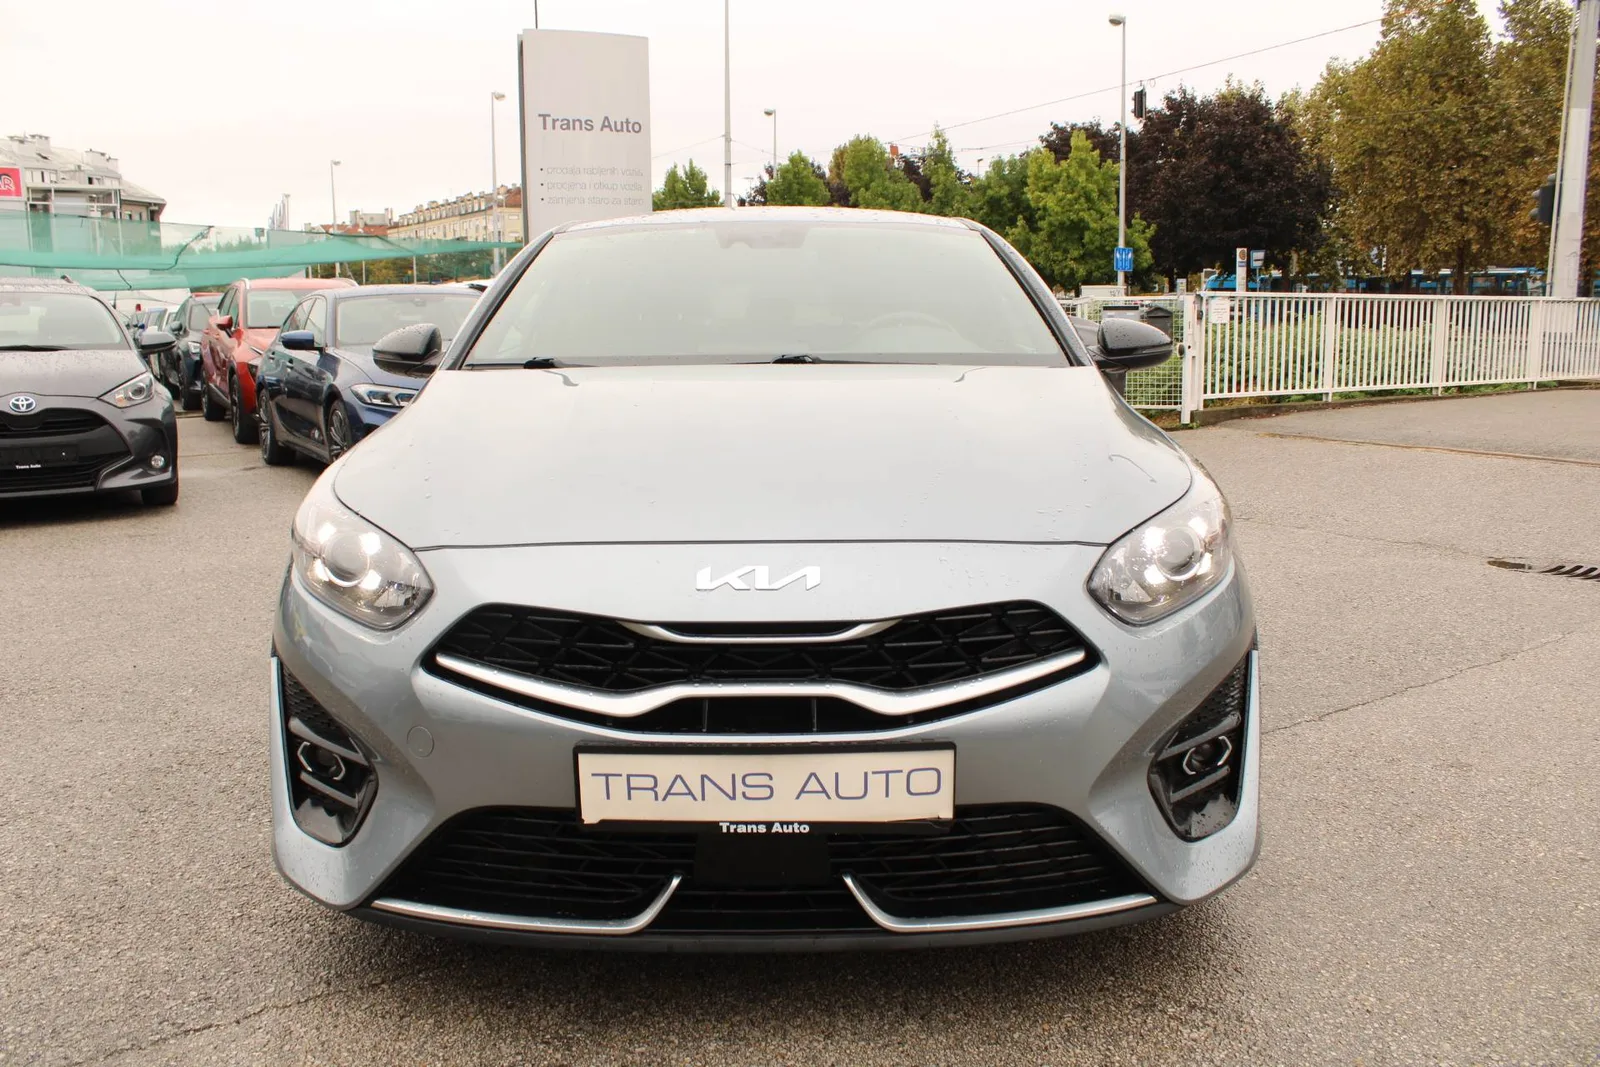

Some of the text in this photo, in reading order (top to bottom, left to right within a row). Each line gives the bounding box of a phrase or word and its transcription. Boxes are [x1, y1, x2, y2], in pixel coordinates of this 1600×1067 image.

[538, 114, 642, 134] Trans Auto
[696, 565, 821, 591] KIA
[591, 767, 942, 802] TRANS AUTO
[719, 822, 810, 834] Trans Auto
